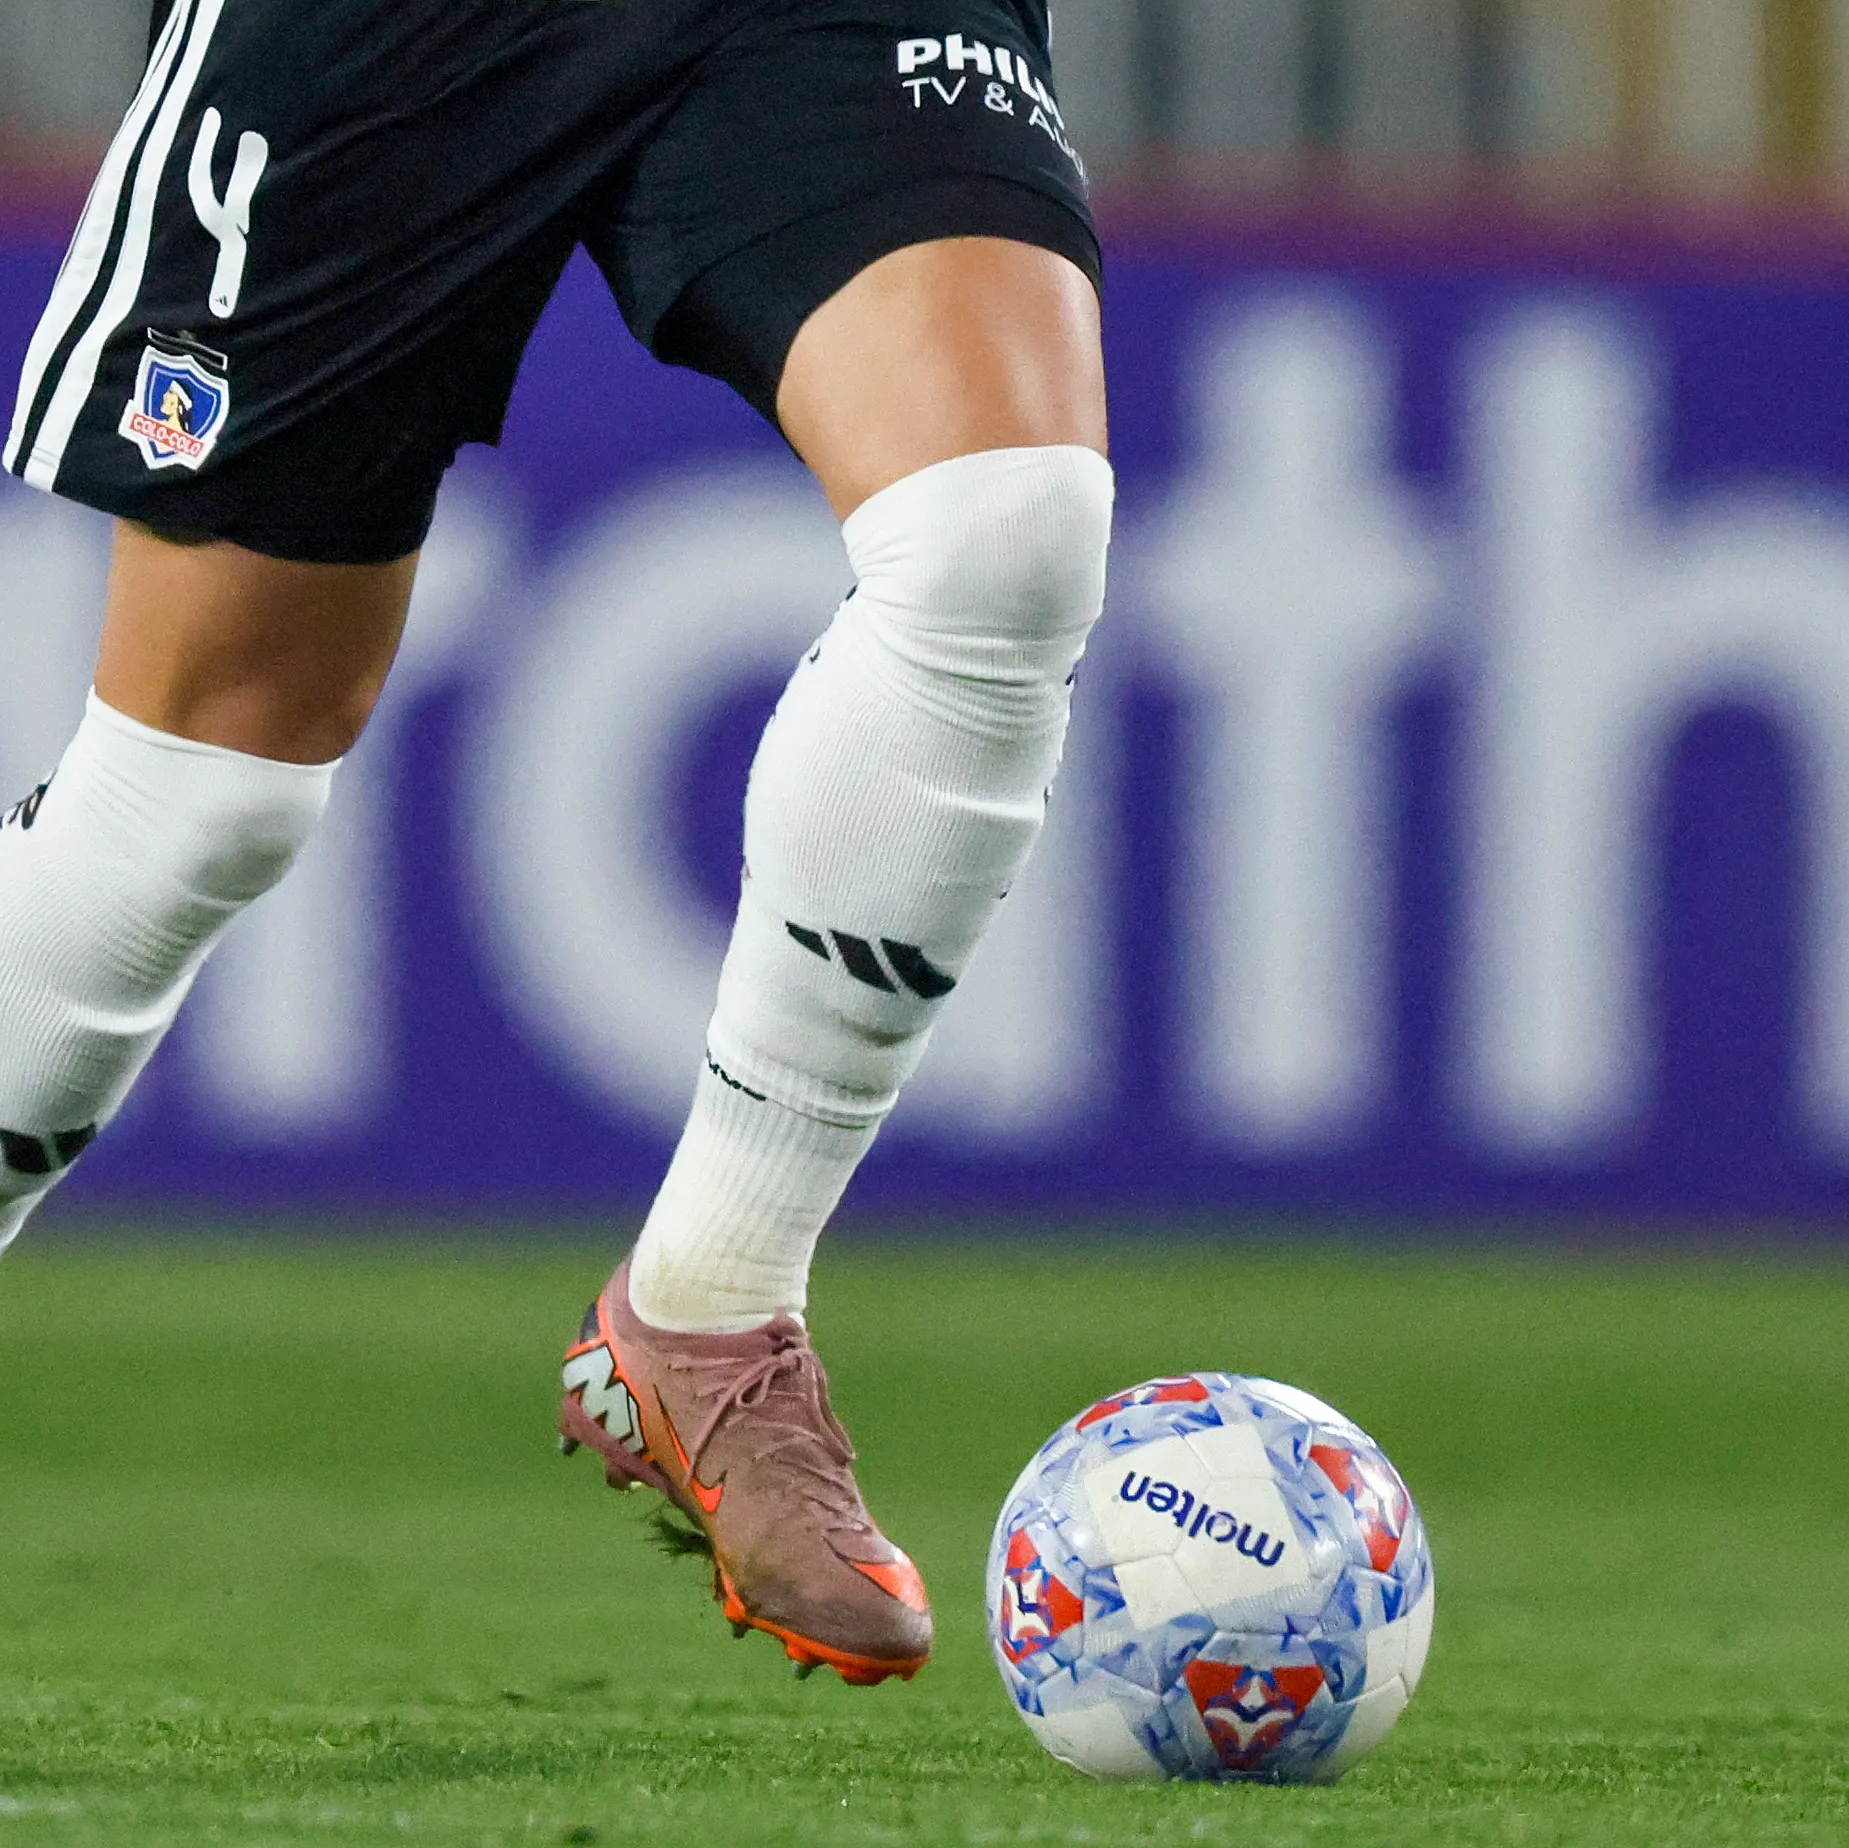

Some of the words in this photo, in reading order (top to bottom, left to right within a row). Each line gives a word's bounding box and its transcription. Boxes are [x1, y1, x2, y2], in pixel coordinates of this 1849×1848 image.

[897, 33, 1065, 130] PHIL
[902, 75, 967, 108] TV
[984, 82, 1015, 116] &
[188, 106, 269, 319] 4
[132, 415, 203, 456] COLO-COLO
[1119, 1470, 1285, 1568] molten
